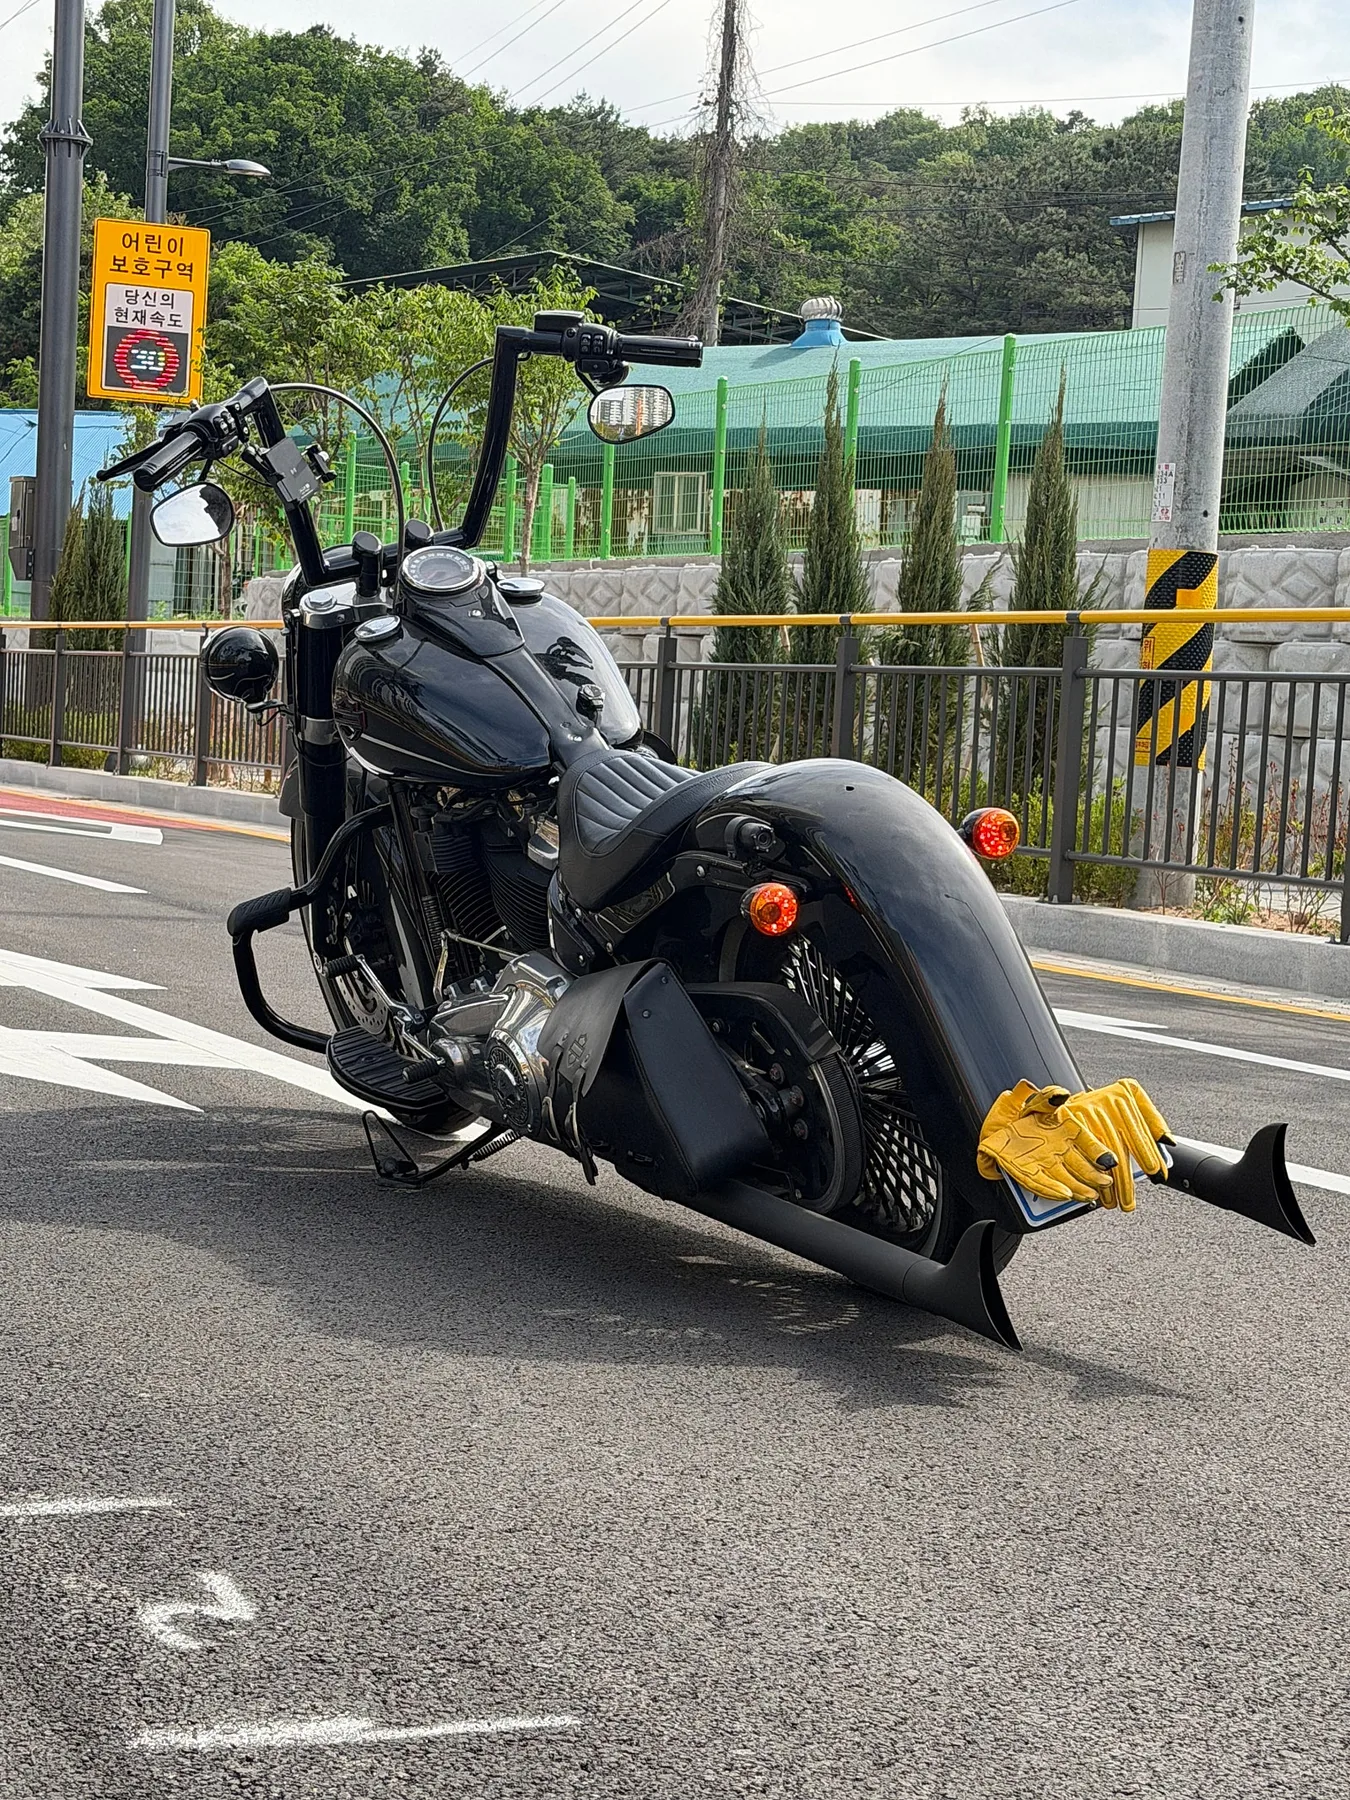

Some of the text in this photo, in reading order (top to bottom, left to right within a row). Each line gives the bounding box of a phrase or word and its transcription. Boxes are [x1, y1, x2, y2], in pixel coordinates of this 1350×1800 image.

[122, 232, 184, 257] 어린이
[109, 255, 194, 282] 보호구역
[125, 289, 175, 310] 당신의
[114, 307, 183, 328] 현재속도
